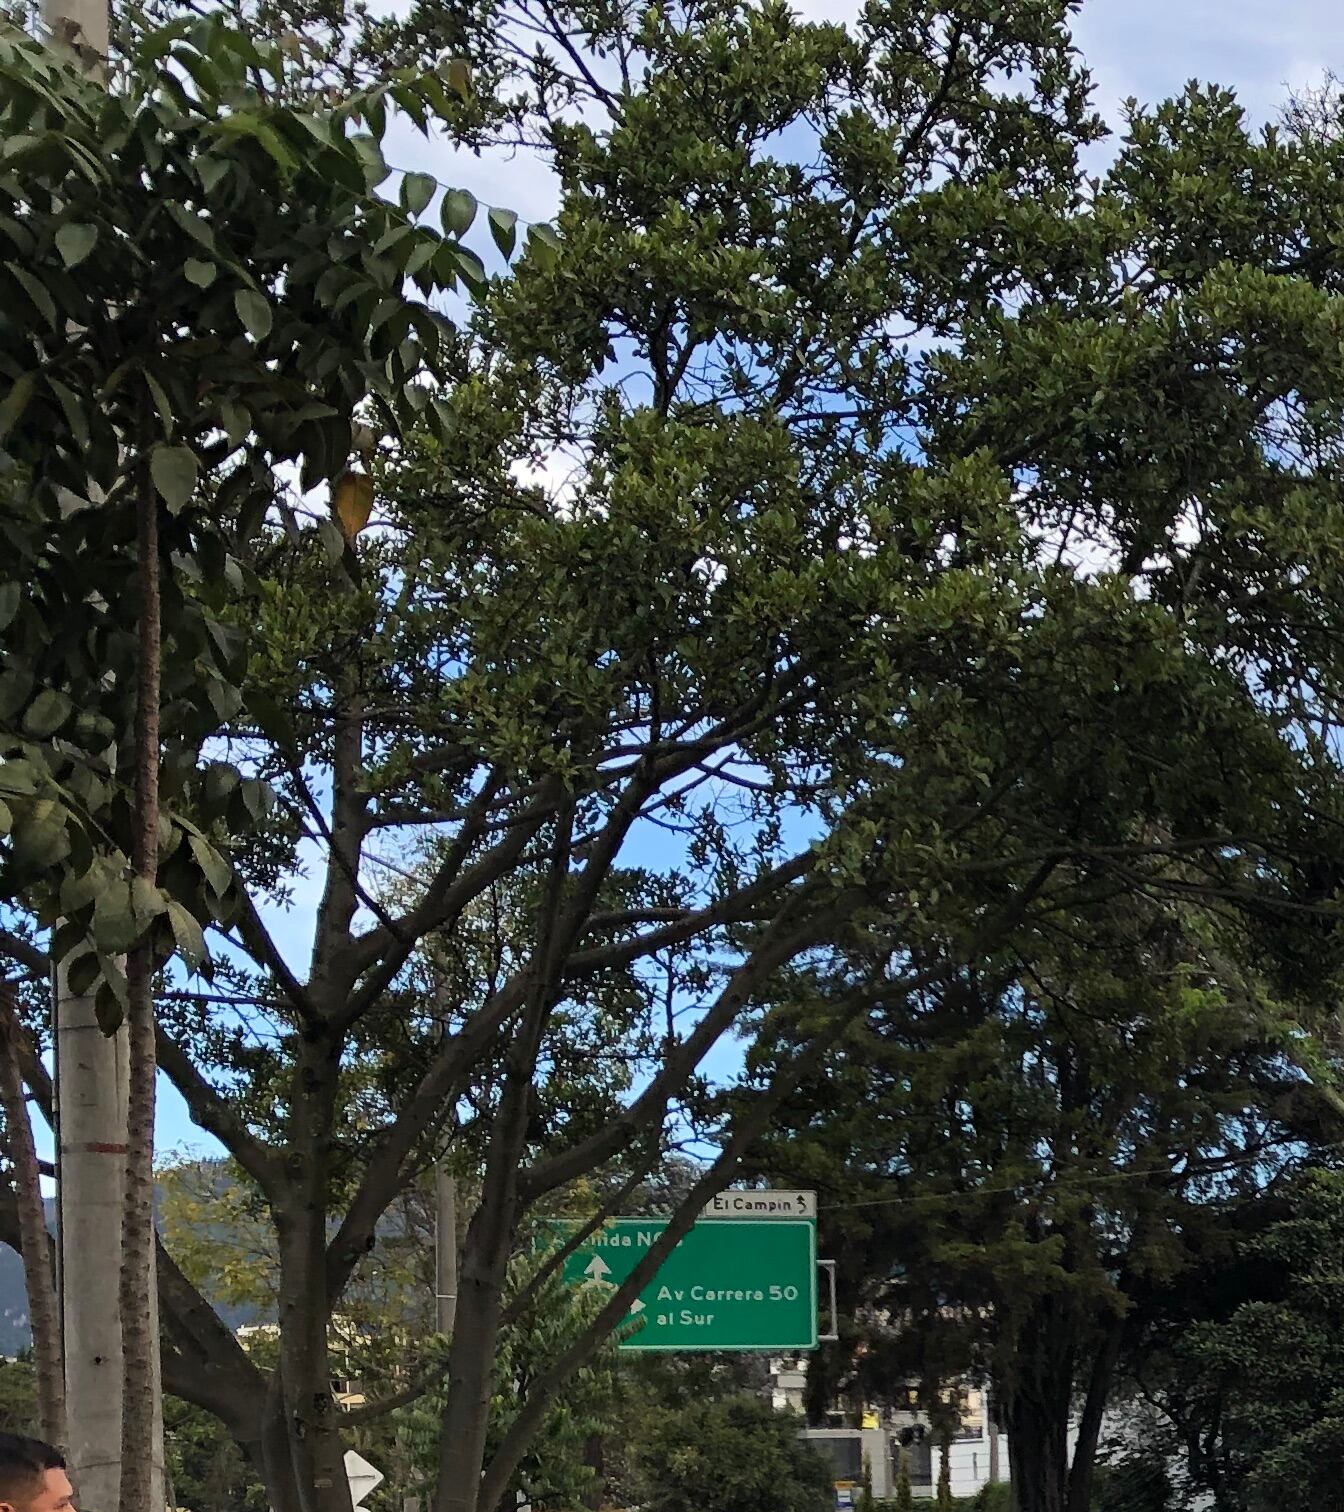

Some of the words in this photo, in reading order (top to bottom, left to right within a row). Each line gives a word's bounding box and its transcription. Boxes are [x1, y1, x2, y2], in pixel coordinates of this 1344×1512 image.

[713, 1197, 729, 1210] El
[657, 1285, 684, 1300] Av
[690, 1285, 764, 1301] Carrera
[768, 1285, 798, 1301] 50
[656, 1311, 674, 1325] al
[679, 1309, 715, 1326] Sur
